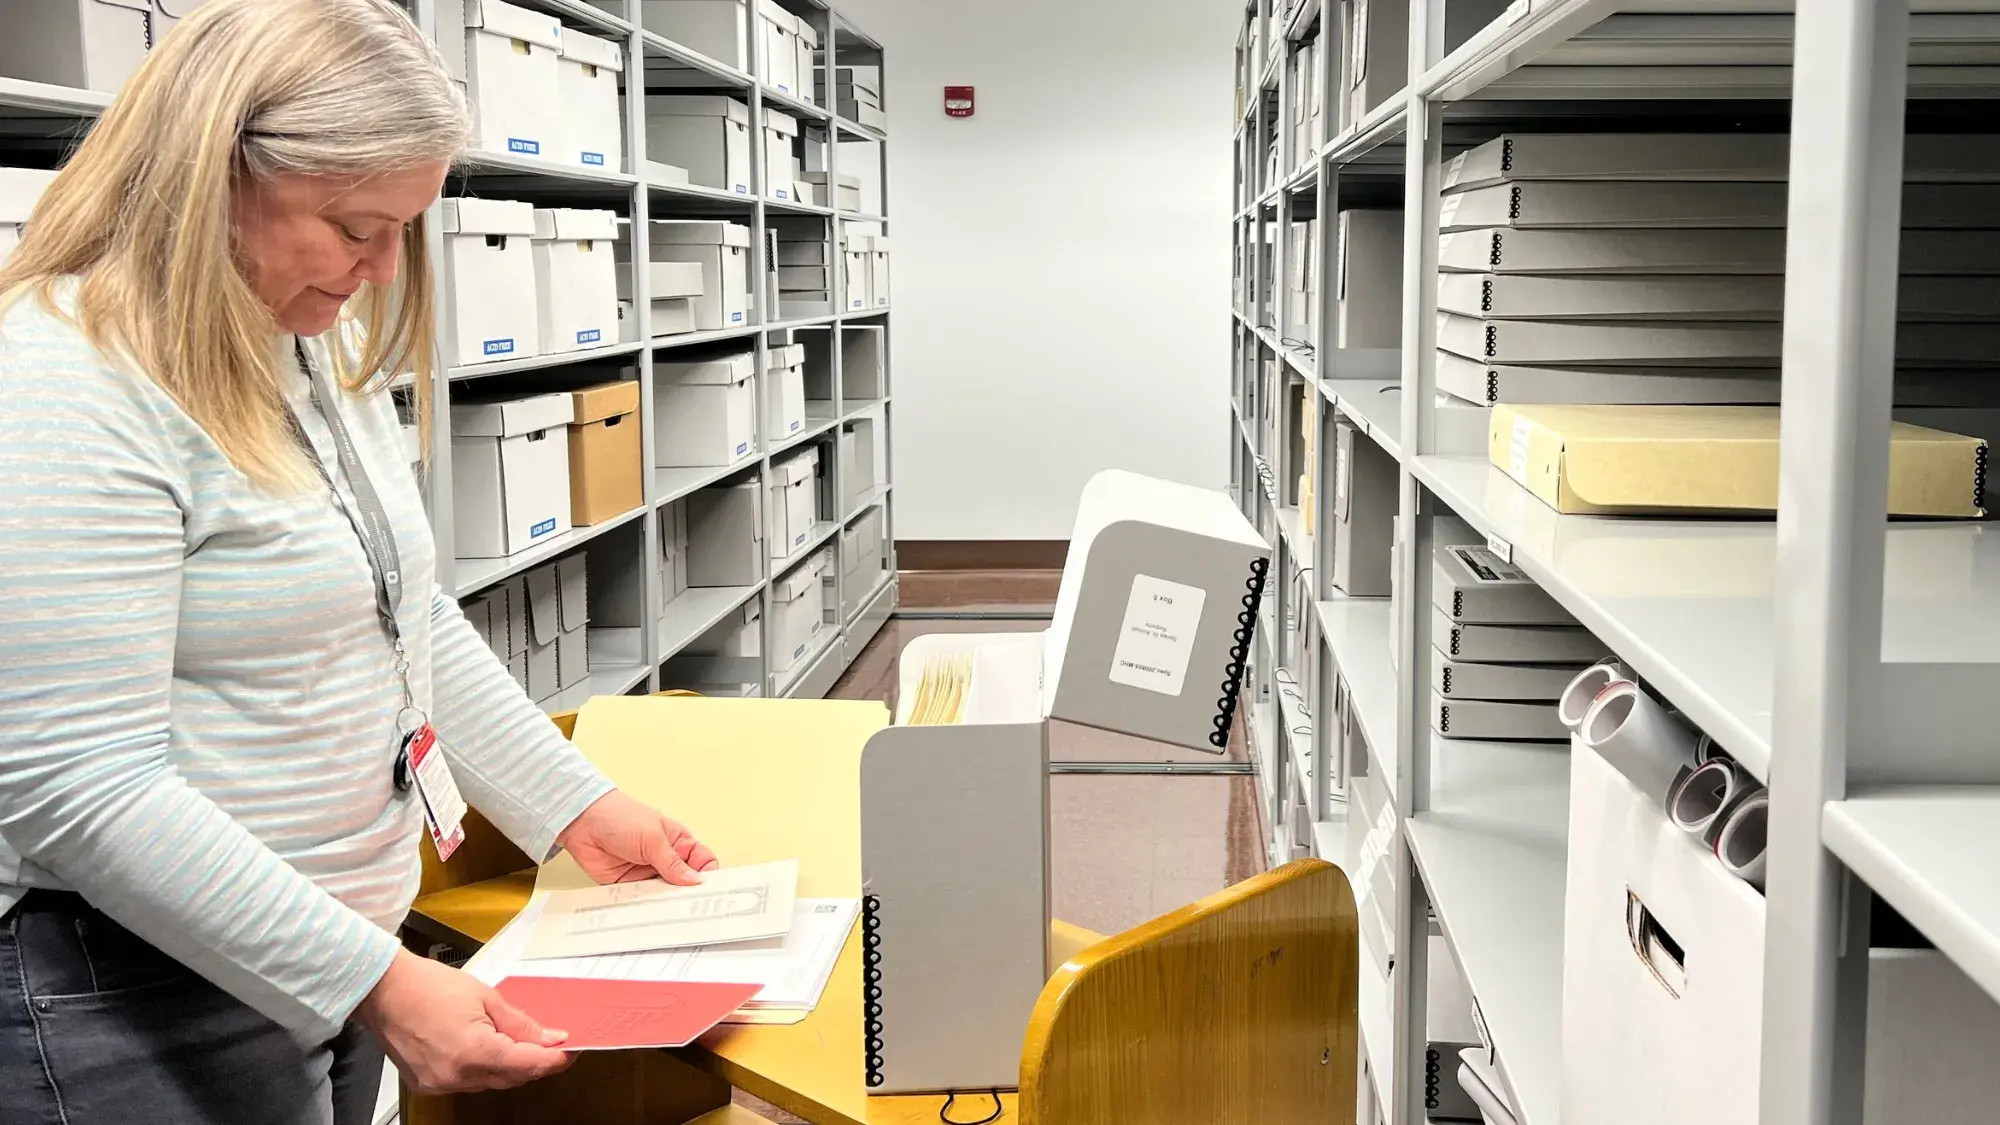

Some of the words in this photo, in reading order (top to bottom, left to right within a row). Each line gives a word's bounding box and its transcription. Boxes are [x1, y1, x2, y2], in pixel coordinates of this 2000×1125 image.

[511, 140, 523, 150] ACID
[523, 142, 536, 152] FREE
[487, 342, 498, 352] ACID
[499, 341, 512, 351] FREE
[1159, 596, 1173, 604] Box
